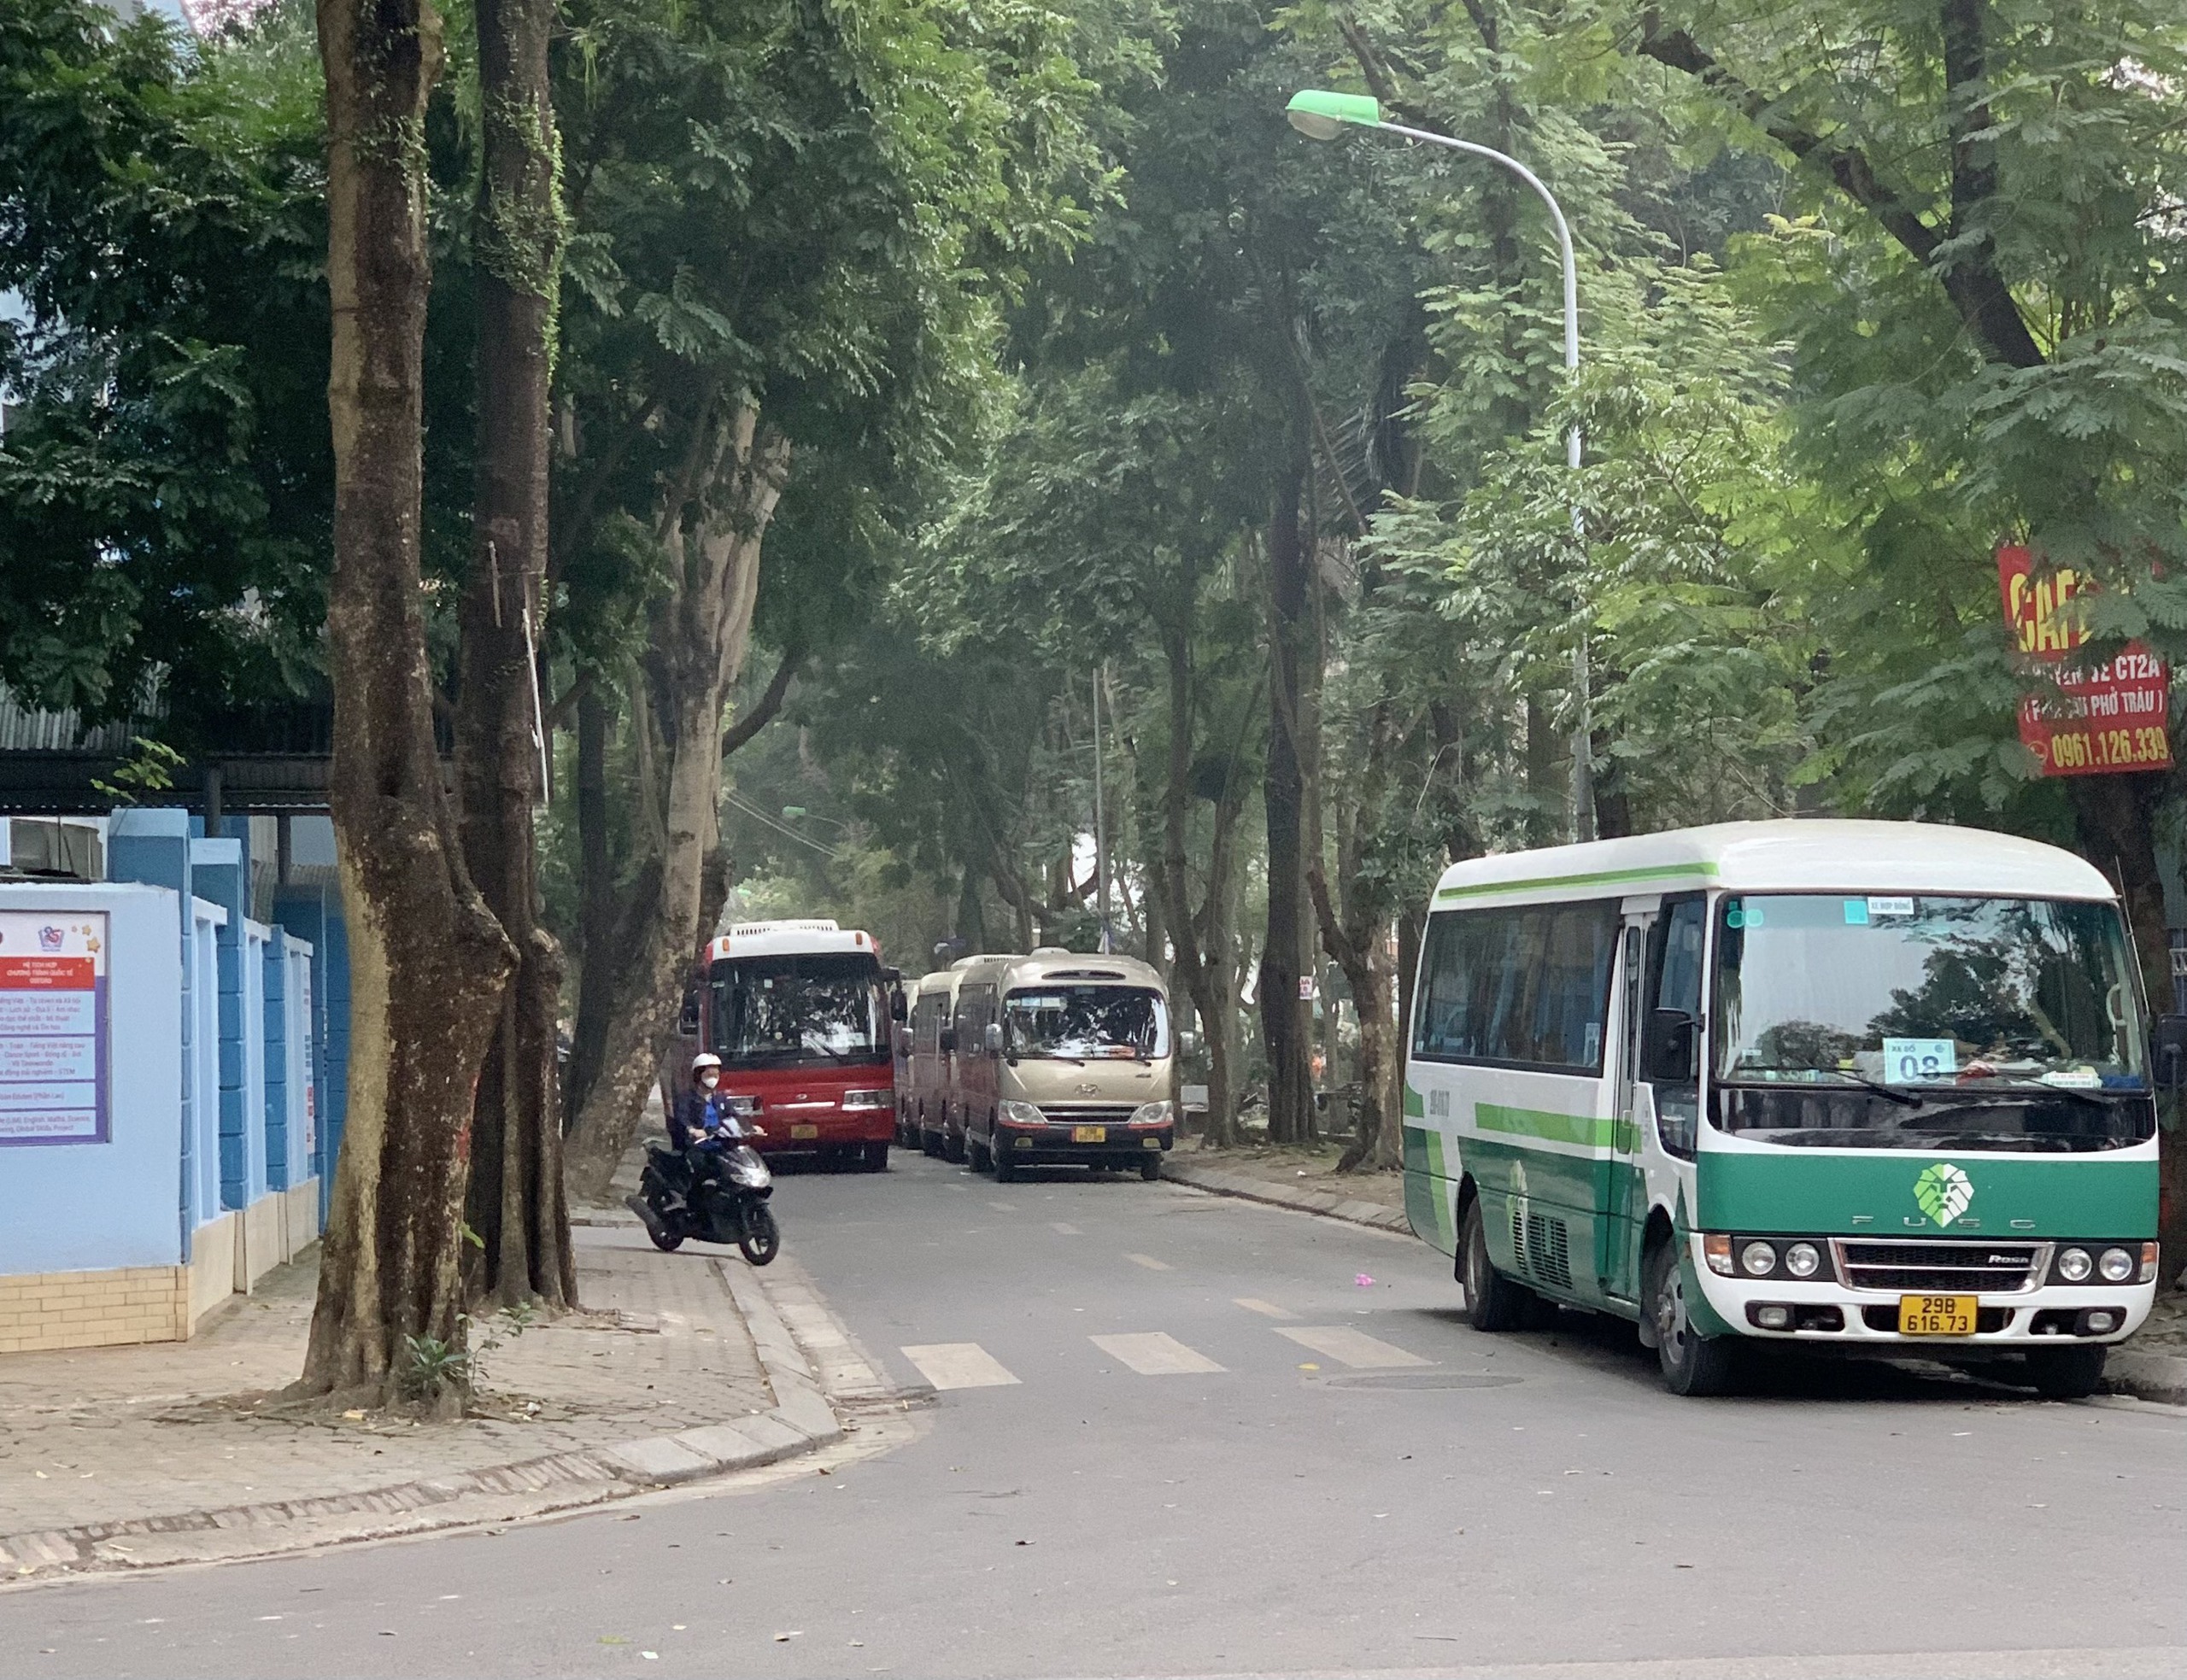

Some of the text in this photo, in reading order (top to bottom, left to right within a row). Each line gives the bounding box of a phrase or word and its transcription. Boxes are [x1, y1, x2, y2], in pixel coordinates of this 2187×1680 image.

[2115, 654, 2161, 681] CT2A
[2090, 686, 2119, 717] PHỞ
[2051, 726, 2168, 768] 0961.126.339
[1900, 1055, 1941, 1081] 08
[1921, 1297, 1955, 1314] 29B
[1907, 1315, 1968, 1332] 616.73
